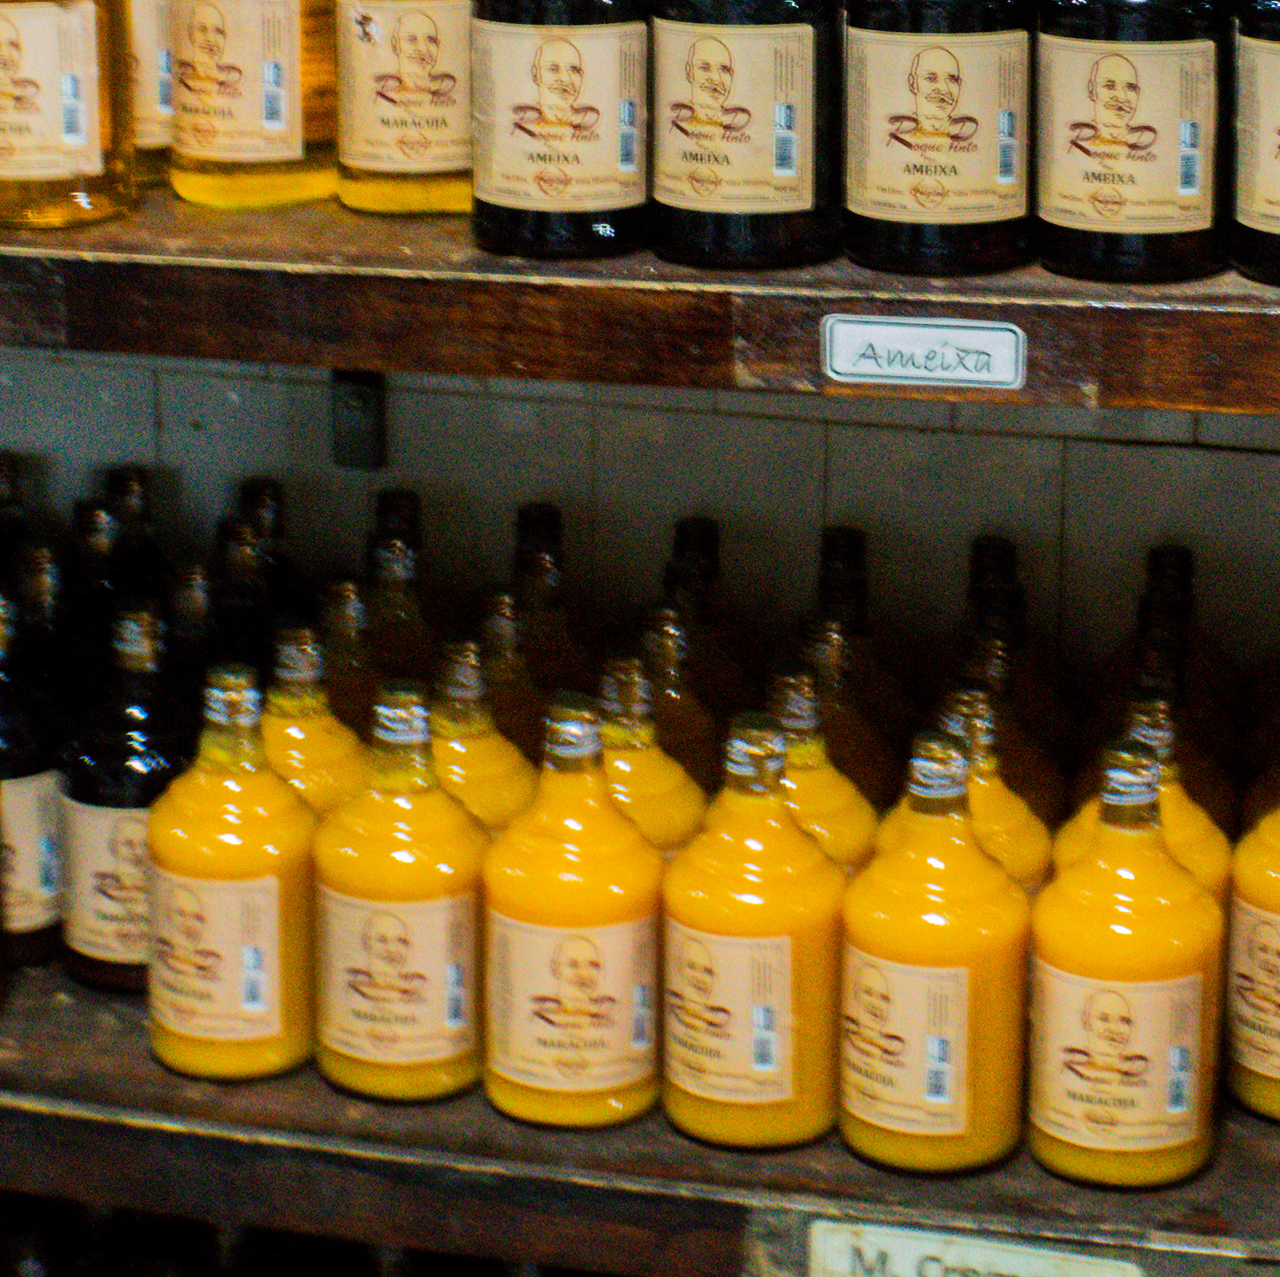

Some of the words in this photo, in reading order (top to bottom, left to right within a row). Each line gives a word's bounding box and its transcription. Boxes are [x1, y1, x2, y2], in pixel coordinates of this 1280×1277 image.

[527, 152, 581, 165] AMEIXA
[681, 151, 730, 165] AMEIXA
[903, 164, 958, 176] AMEIXA
[1083, 172, 1137, 185] AMEIXA
